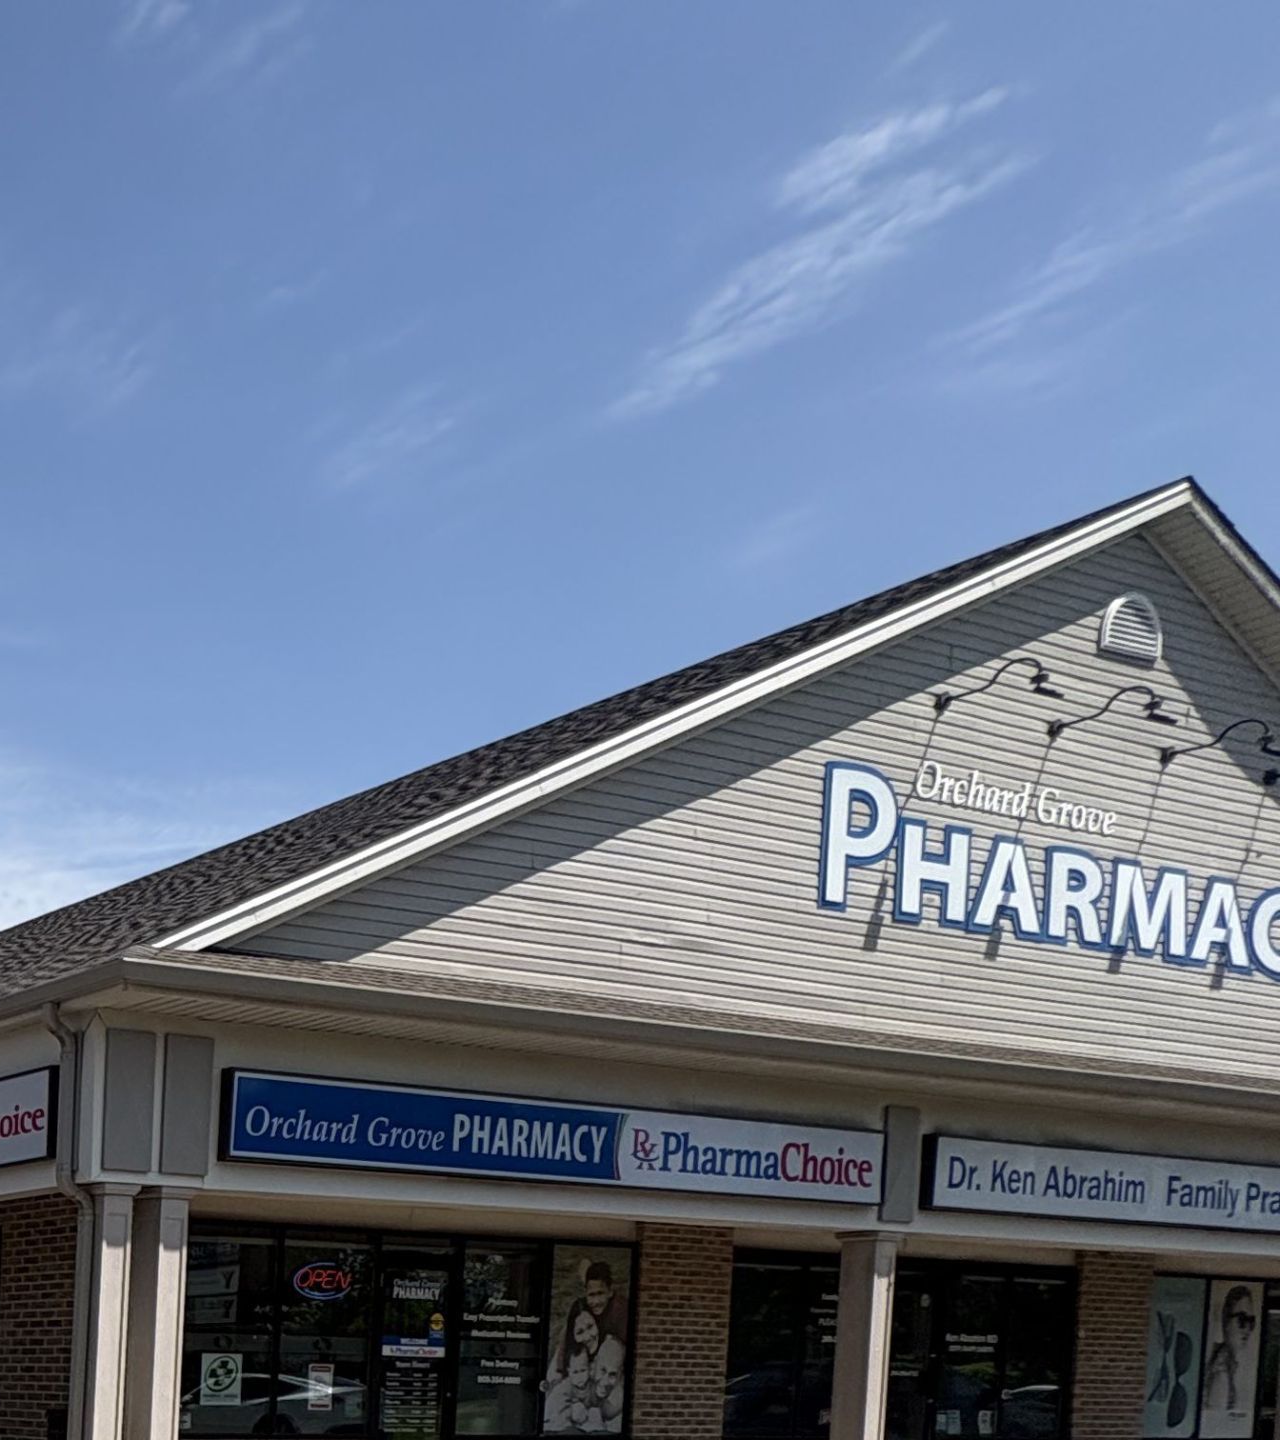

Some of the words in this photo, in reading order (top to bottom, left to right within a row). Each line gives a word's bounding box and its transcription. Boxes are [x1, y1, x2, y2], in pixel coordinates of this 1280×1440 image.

[915, 759, 1032, 818] Orchard
[1037, 787, 1117, 836] Grove
[244, 1105, 359, 1145] Orchard
[367, 1116, 445, 1152] Grove
[451, 1113, 608, 1164] PHARMACY
[659, 1131, 873, 1188] PharmaChoice
[947, 1155, 982, 1191] Dr.
[990, 1159, 1036, 1196] Ken
[1042, 1165, 1146, 1205] Abrahim
[1166, 1175, 1240, 1218] Family
[297, 1268, 352, 1290] OPEN
[392, 1286, 441, 1300] PHARMACY
